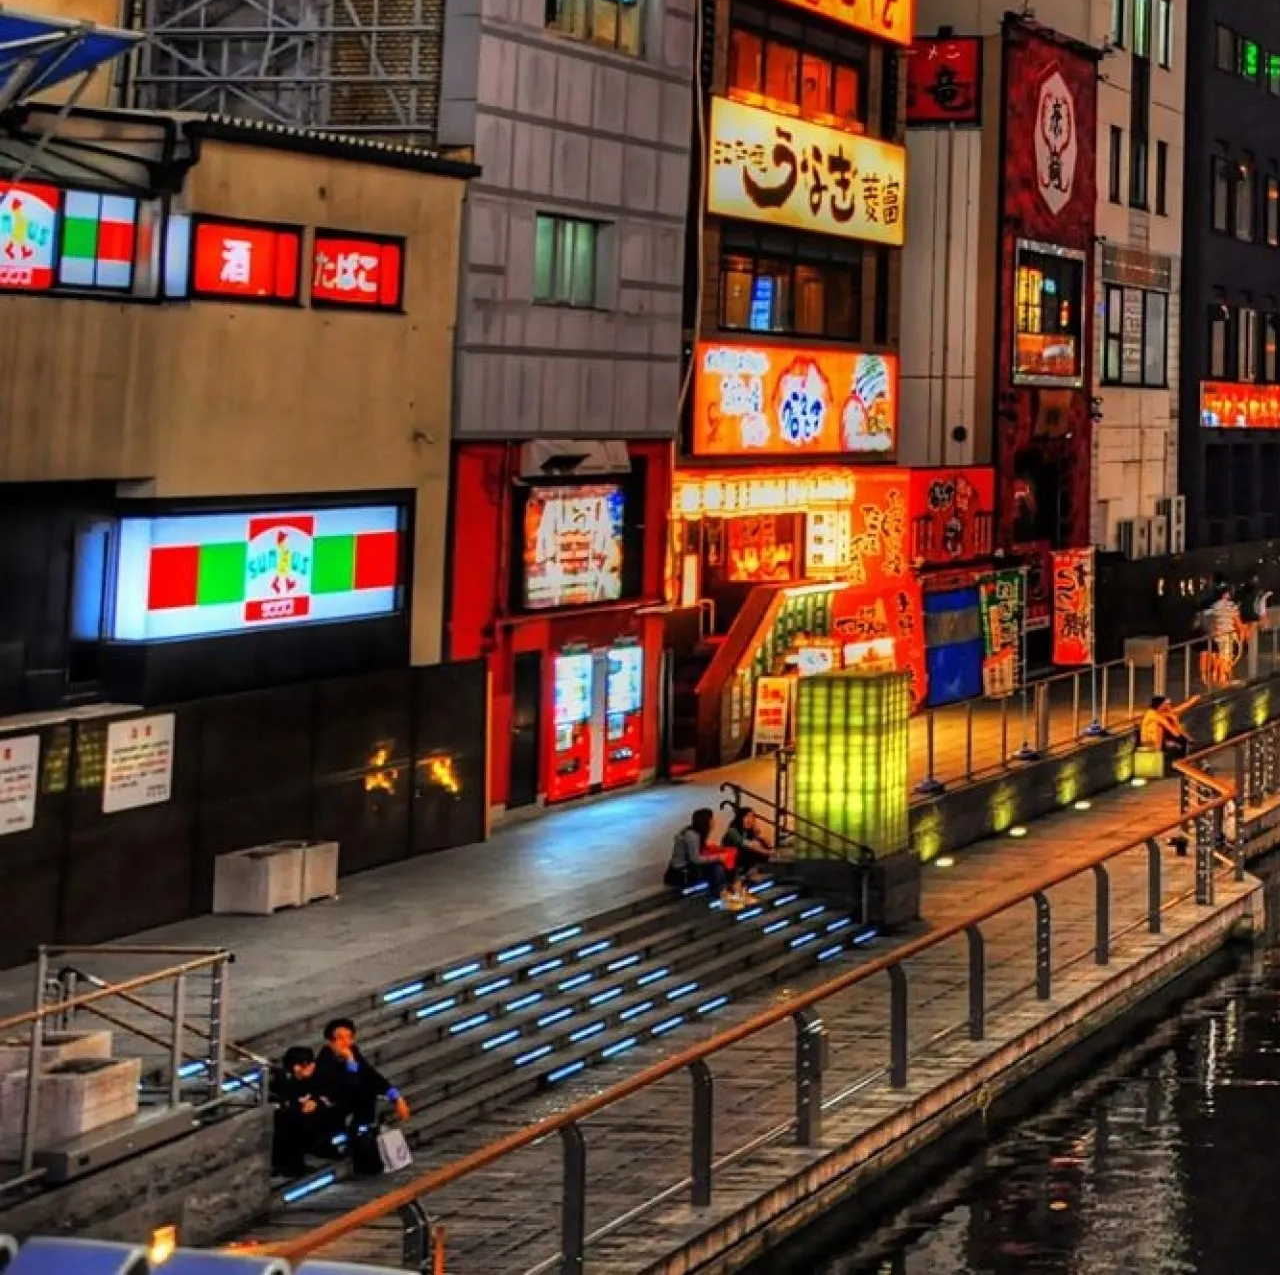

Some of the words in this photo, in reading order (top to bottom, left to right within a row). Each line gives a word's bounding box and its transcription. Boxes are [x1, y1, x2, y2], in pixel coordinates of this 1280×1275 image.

[742, 126, 858, 224] うなぎ
[219, 238, 252, 284] 酒
[314, 250, 379, 293] たばこ
